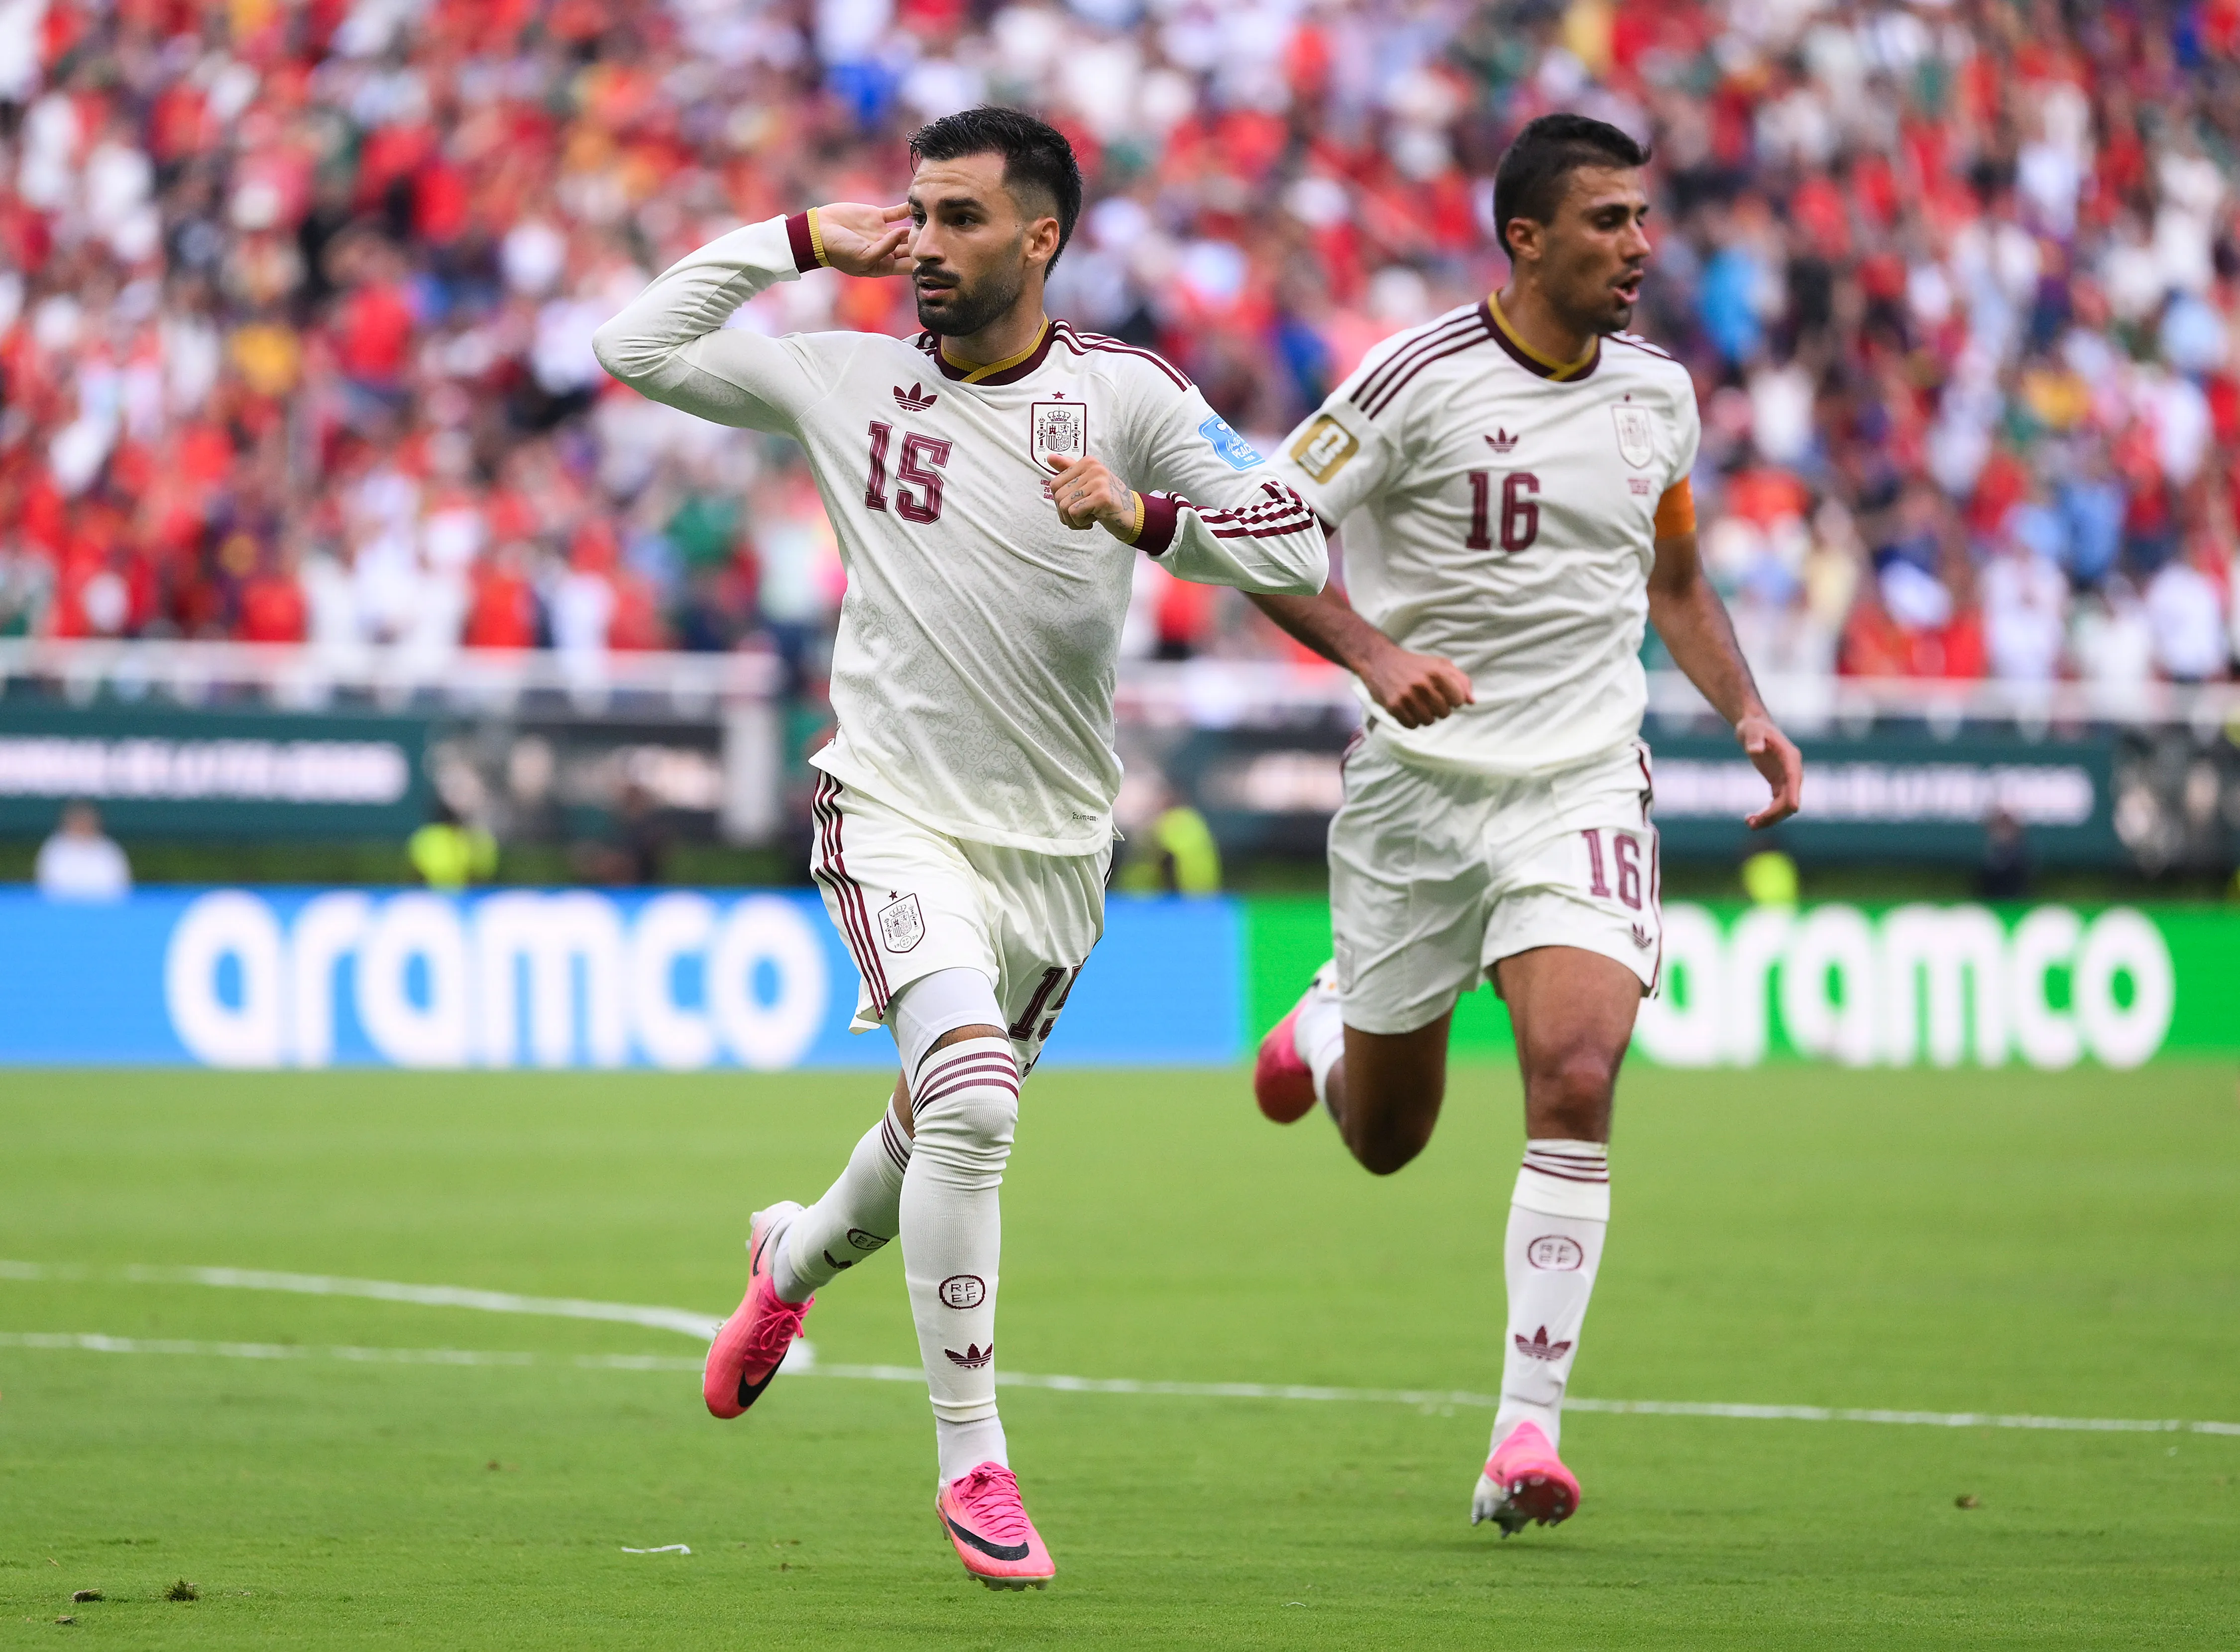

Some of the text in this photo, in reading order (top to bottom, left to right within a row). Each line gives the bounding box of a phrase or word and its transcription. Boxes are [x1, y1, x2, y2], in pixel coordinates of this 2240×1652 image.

[865, 420, 953, 525] 15
[1466, 471, 1540, 552] 16
[1580, 828, 1642, 911] 16
[166, 889, 826, 1070] aramco
[1638, 903, 2175, 1068] aramco
